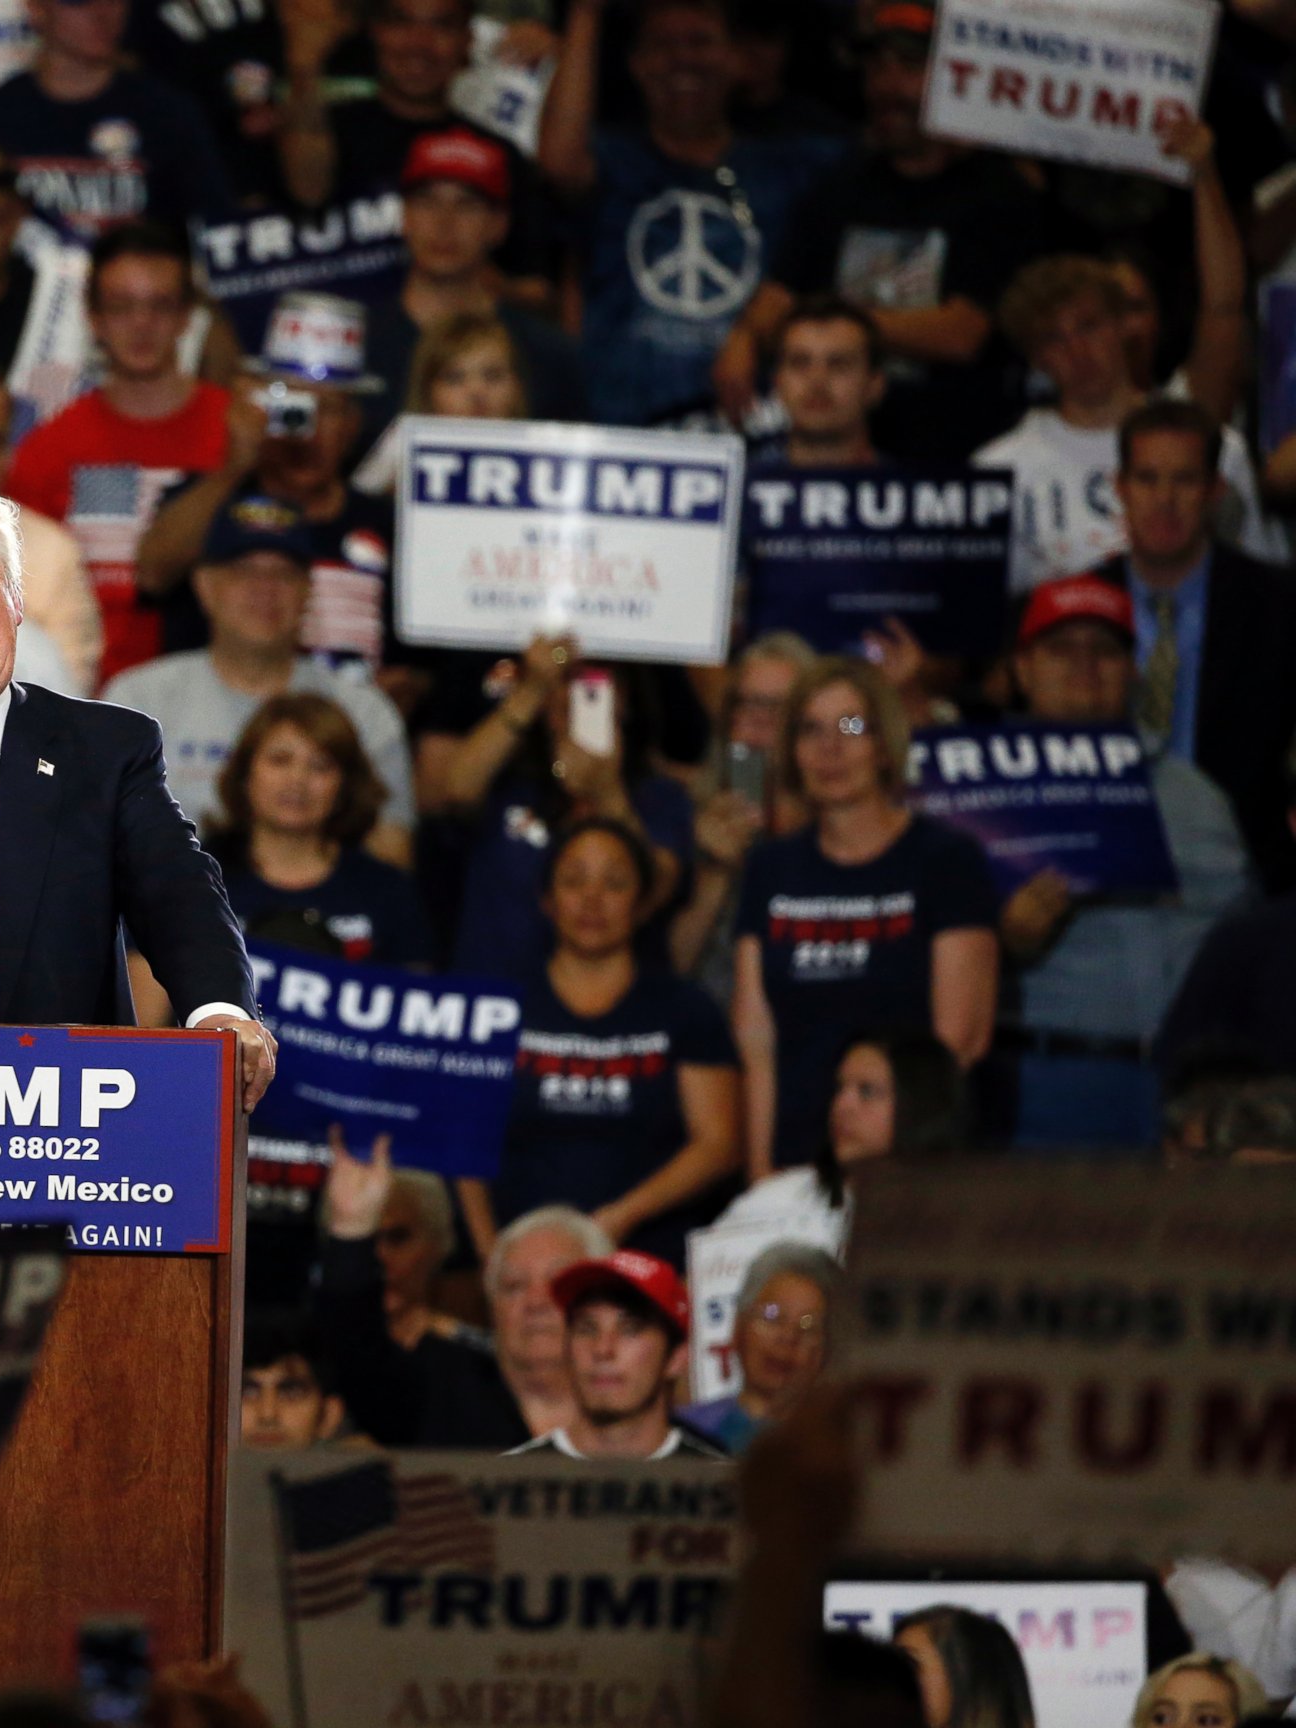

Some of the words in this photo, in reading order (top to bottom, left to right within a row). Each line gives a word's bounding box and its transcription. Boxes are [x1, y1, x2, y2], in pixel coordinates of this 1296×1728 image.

[198, 192, 407, 271] TRUM
[415, 454, 717, 518] TRUMP
[747, 478, 1011, 531] TRUMP
[8, 1136, 100, 1160] 88022
[47, 1174, 174, 1204] Mexico
[65, 1224, 163, 1248] AGAIN!
[471, 1478, 738, 1519] VETERANS
[628, 1524, 734, 1565] FOR
[386, 1678, 688, 1728] AMERICA
